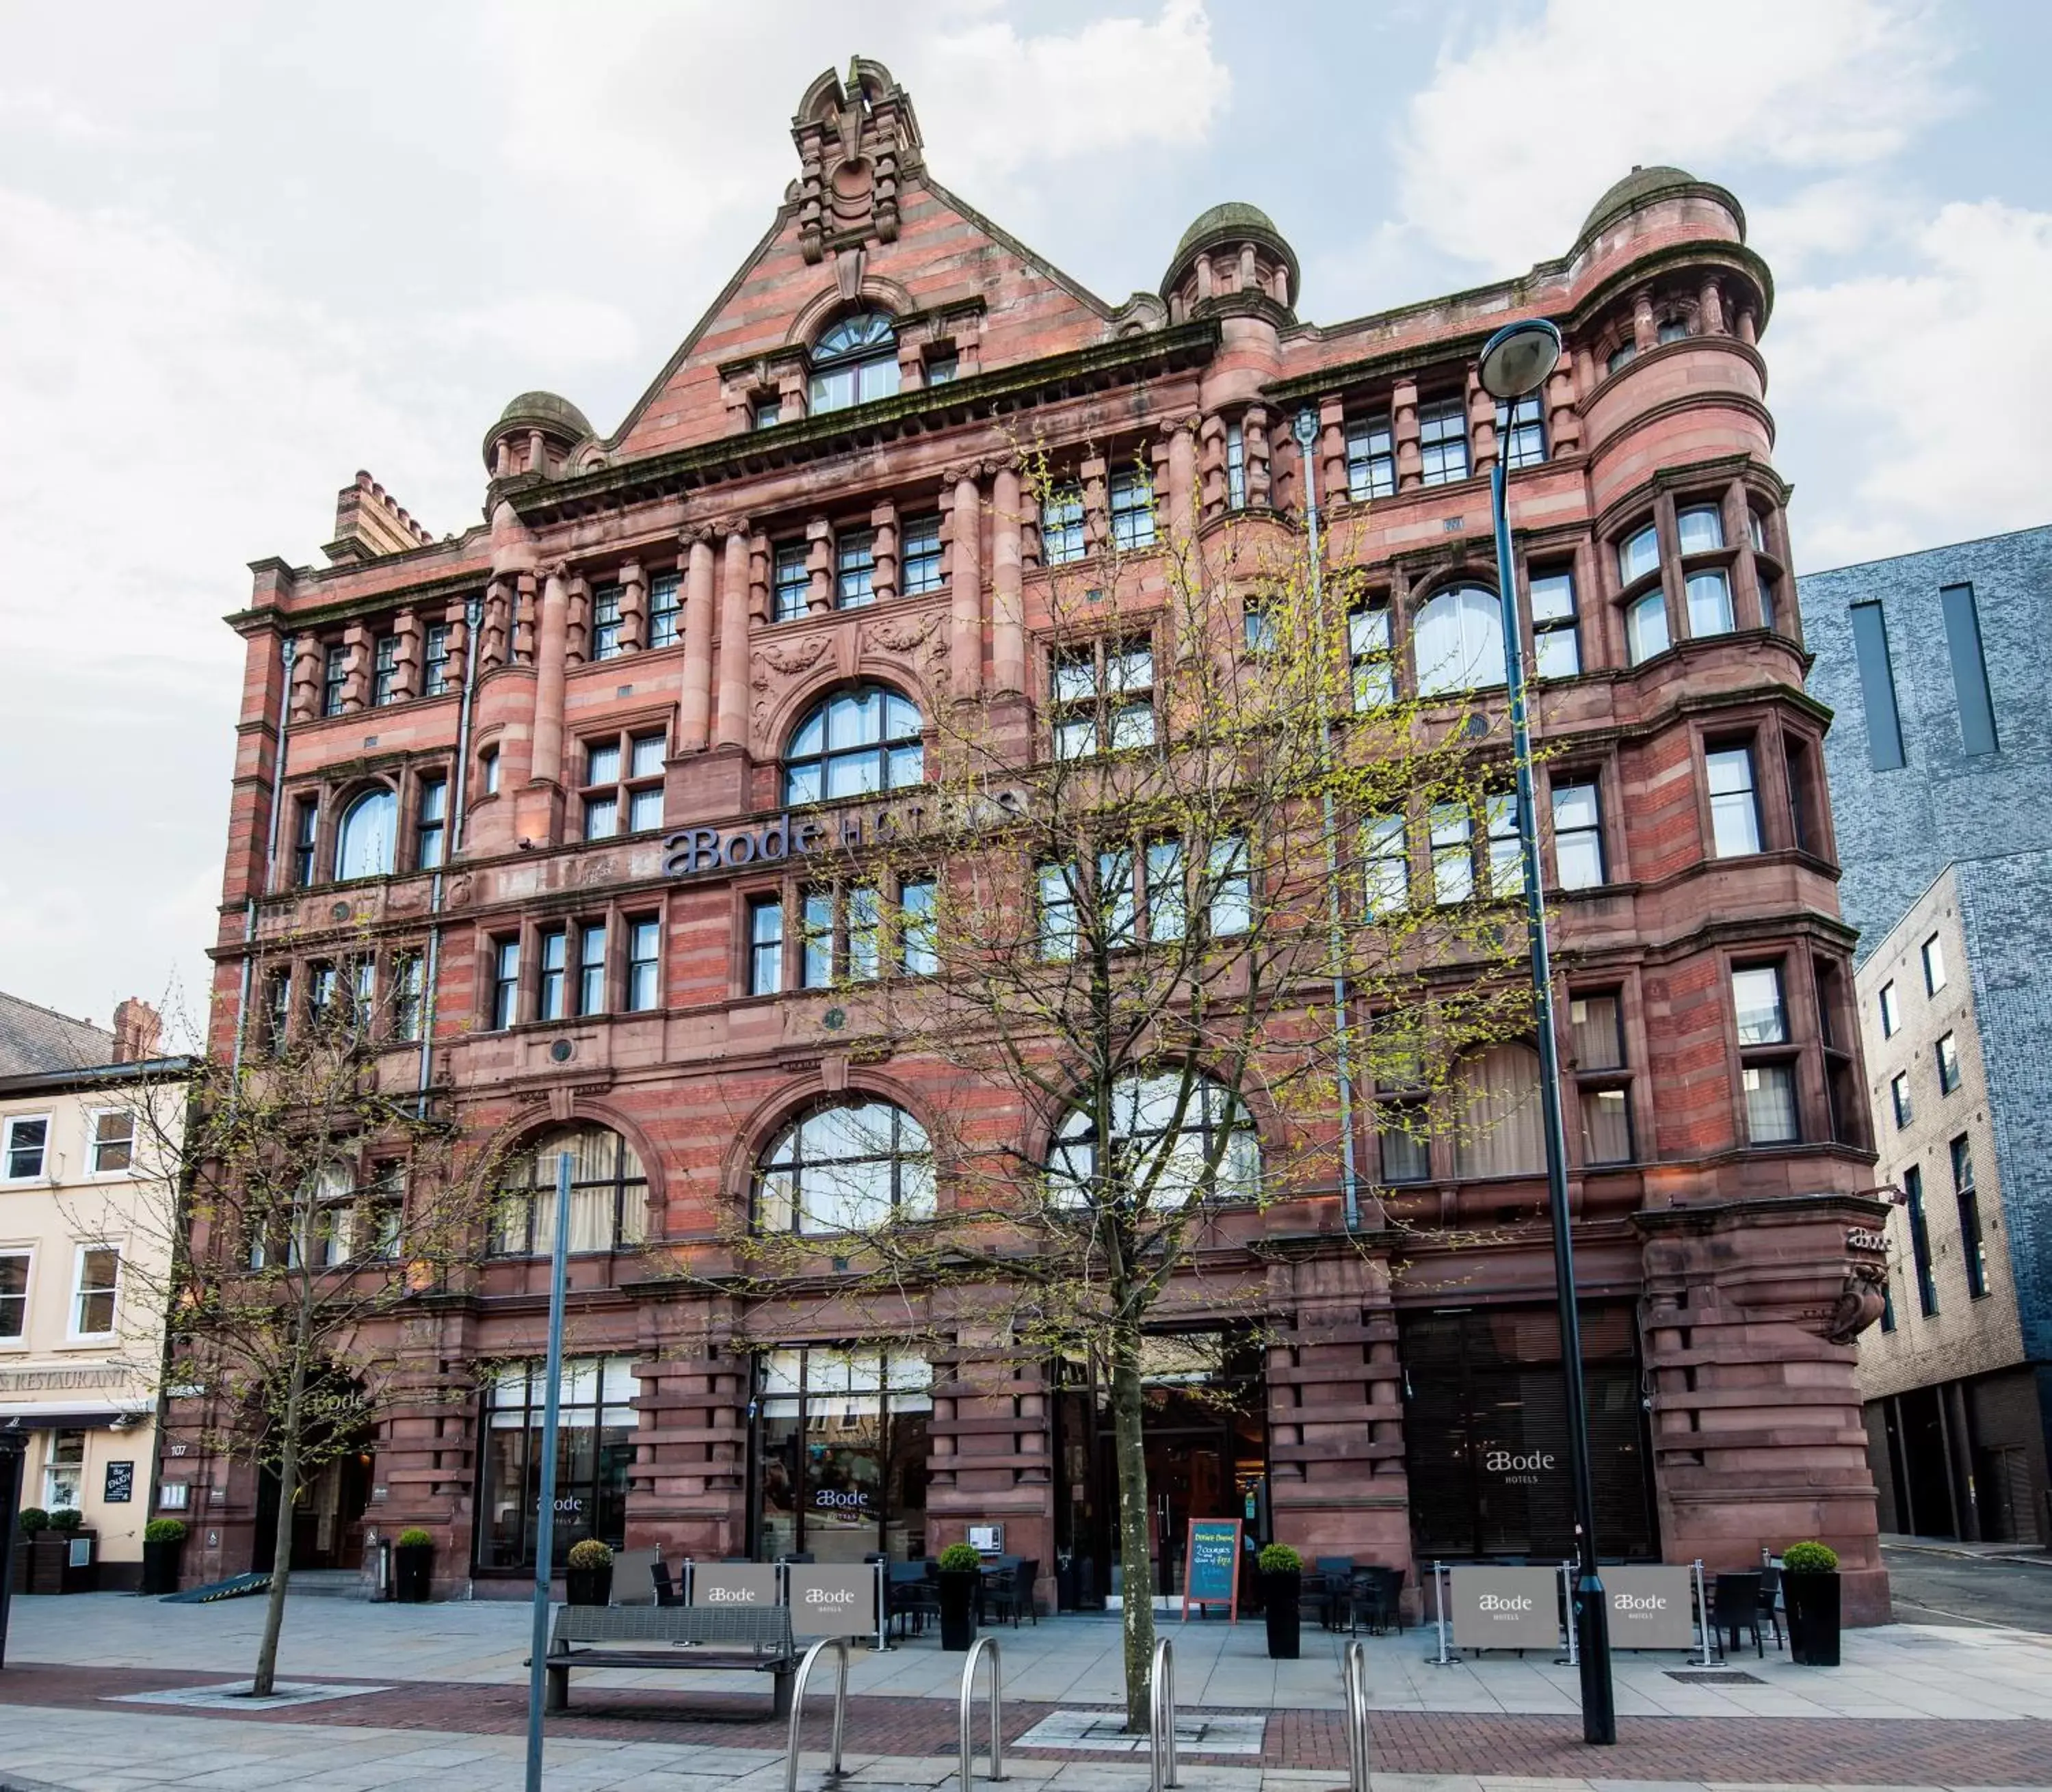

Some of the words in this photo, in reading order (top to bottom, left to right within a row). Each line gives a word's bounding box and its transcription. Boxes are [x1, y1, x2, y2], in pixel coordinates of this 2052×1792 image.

[16, 1369, 127, 1391] RESTAURANT
[171, 1445, 186, 1455] 107
[1505, 1475, 1538, 1484] HOTELS
